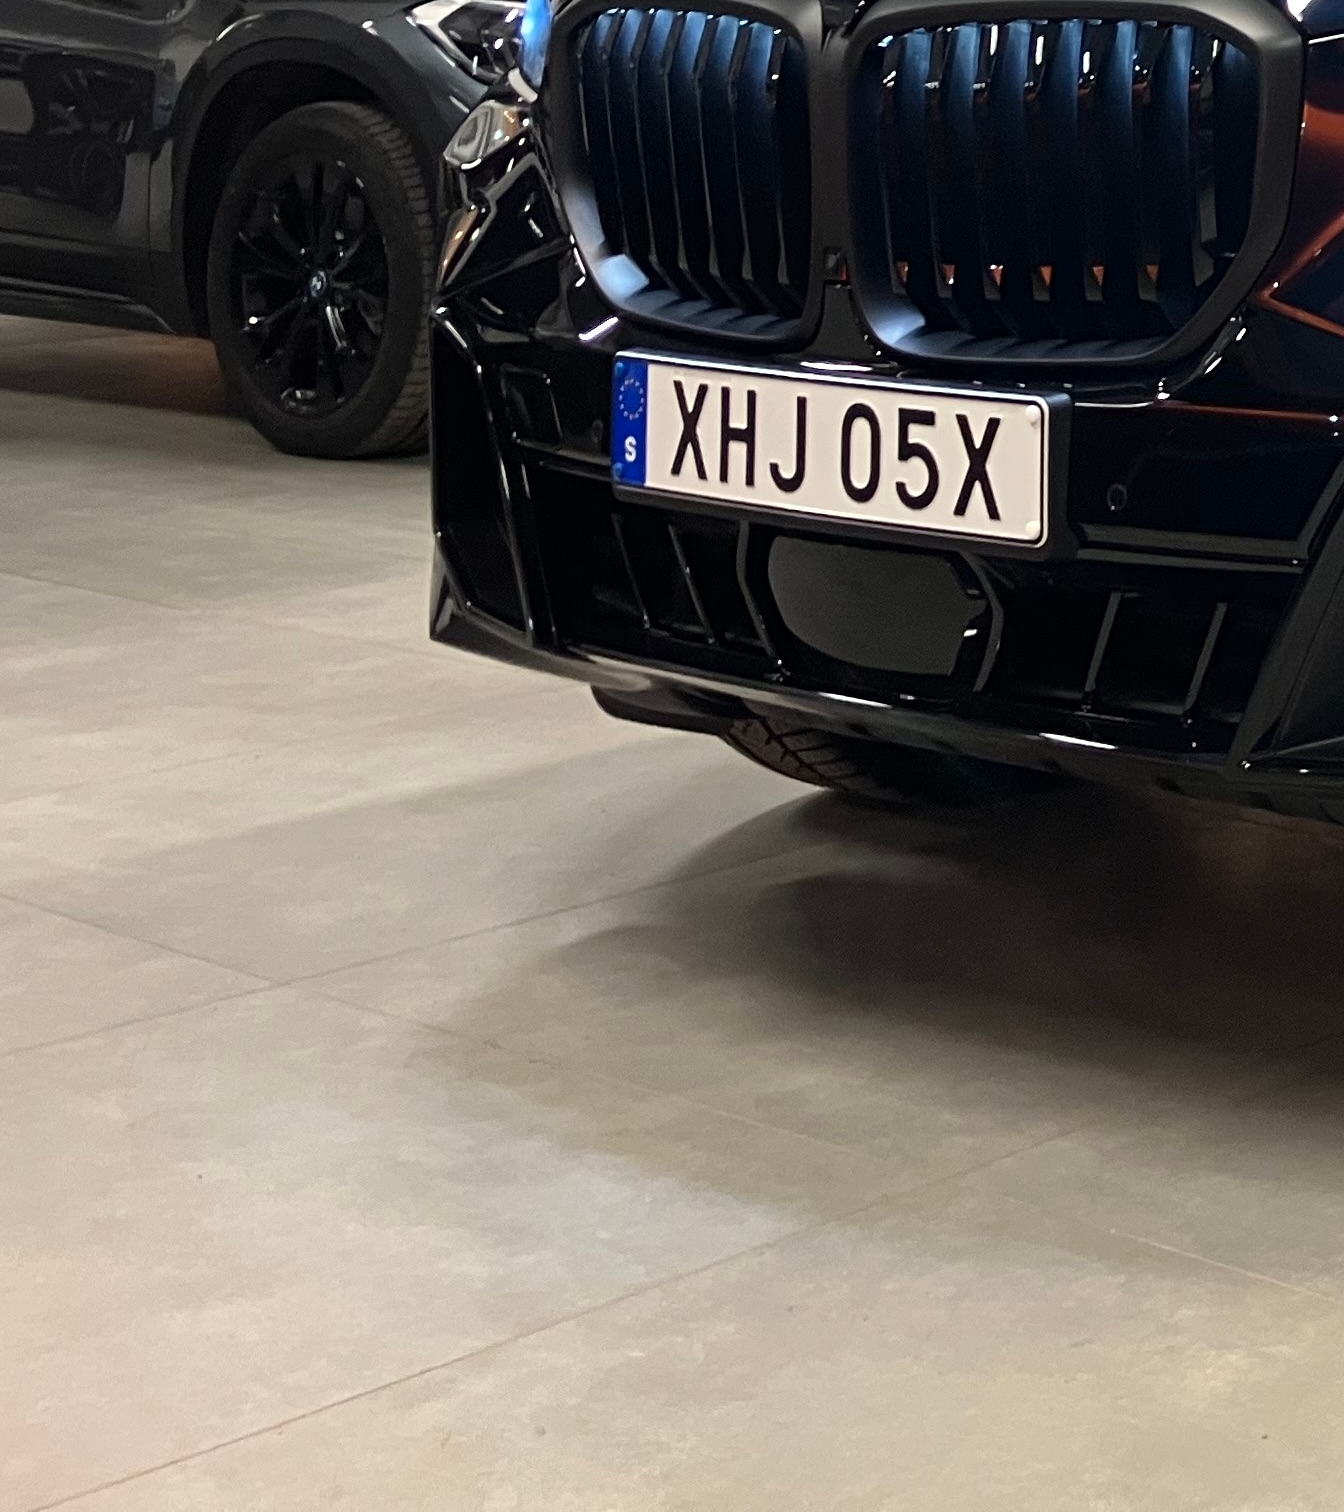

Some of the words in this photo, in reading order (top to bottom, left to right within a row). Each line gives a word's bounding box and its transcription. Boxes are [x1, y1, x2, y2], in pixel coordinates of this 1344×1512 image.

[624, 435, 637, 462] S
[670, 379, 807, 493] XHJ
[840, 402, 1001, 522] 05X
